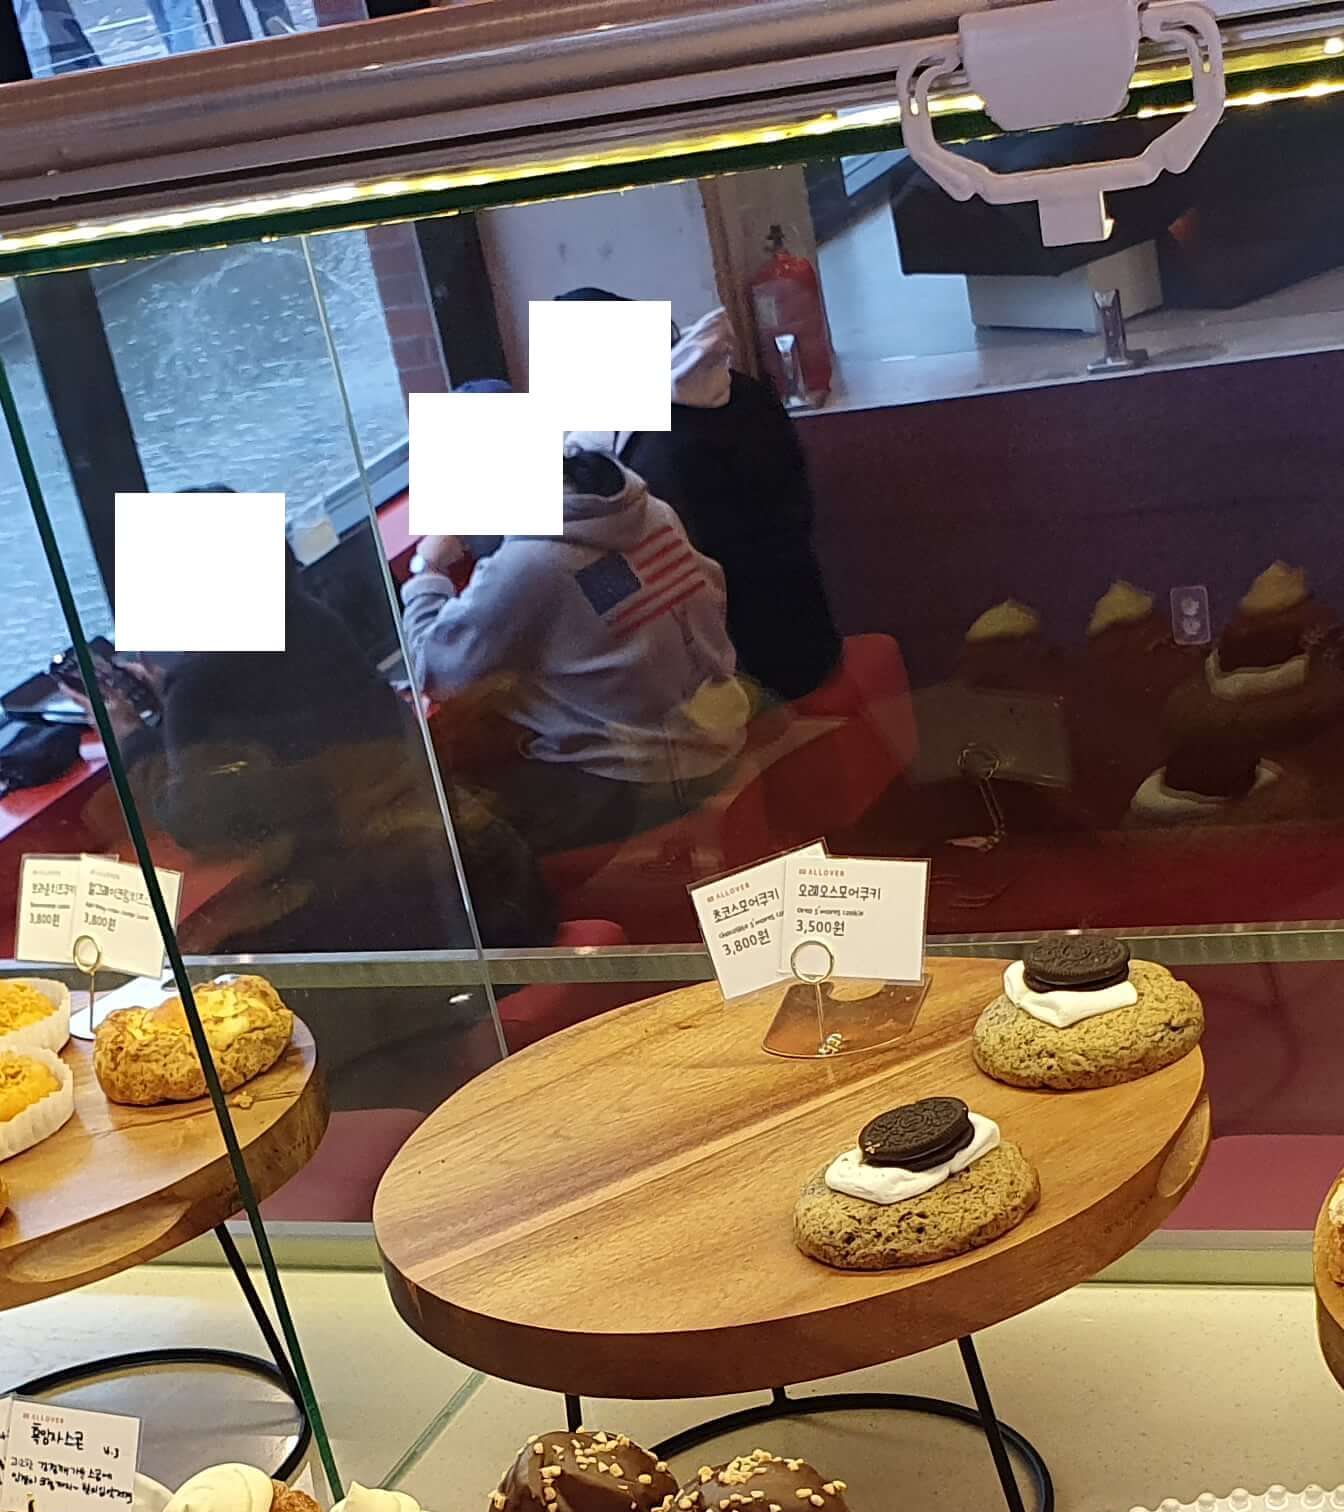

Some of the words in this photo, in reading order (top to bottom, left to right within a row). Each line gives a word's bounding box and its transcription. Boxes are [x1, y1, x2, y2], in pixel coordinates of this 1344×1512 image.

[798, 883, 881, 901] 오레오스모어쿠키
[713, 887, 779, 923] 초코스모어쿠키
[795, 919, 845, 937] 3,500원
[722, 928, 771, 956] 3,800원
